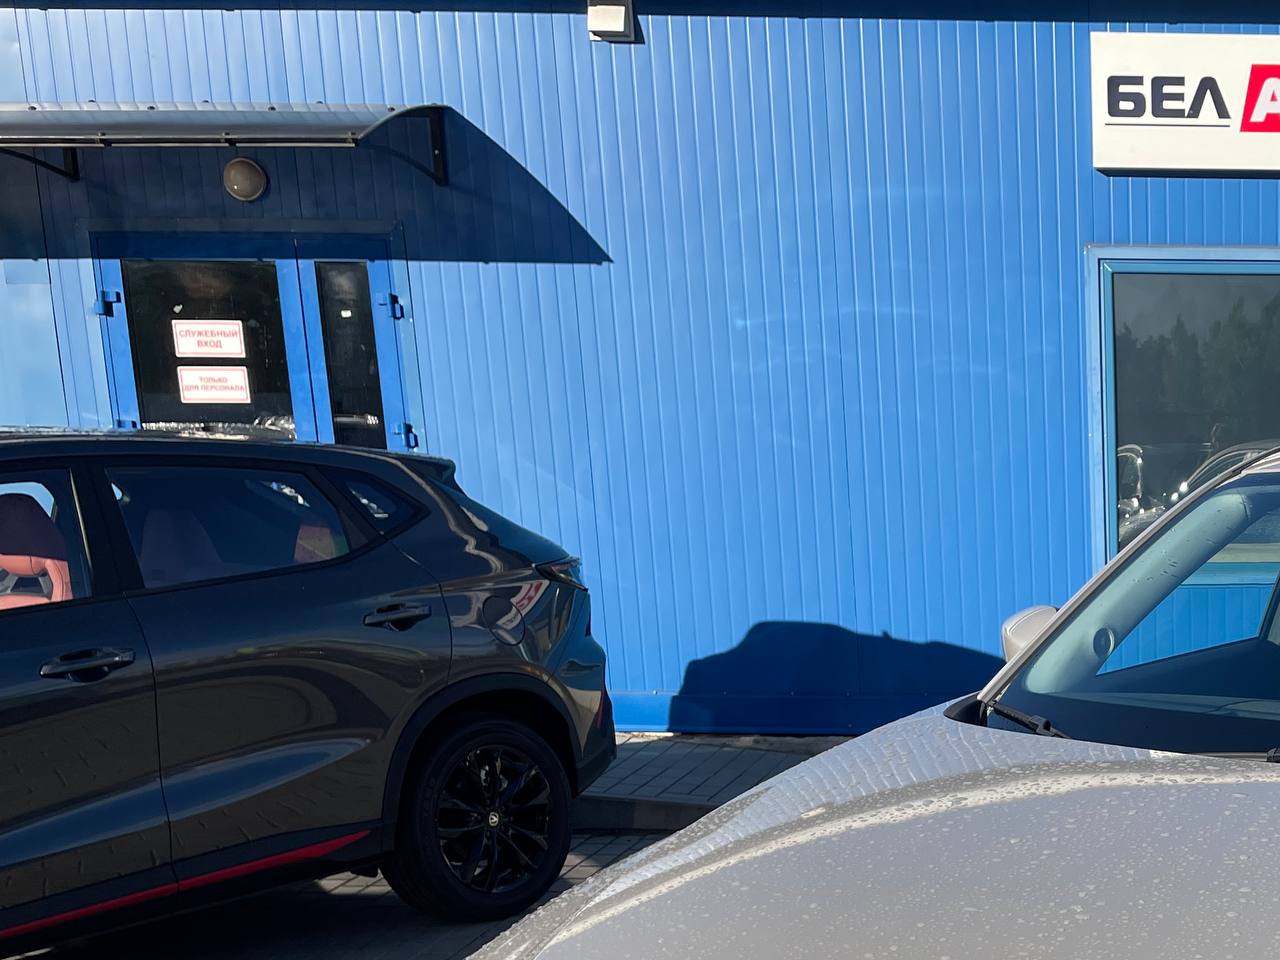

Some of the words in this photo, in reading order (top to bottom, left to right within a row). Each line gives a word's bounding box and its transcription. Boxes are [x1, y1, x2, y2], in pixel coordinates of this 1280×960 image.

[1106, 75, 1230, 120] БЕЛ
[179, 328, 238, 338] СЛУЖЕБНЫЙ
[196, 339, 223, 349] ВХОД
